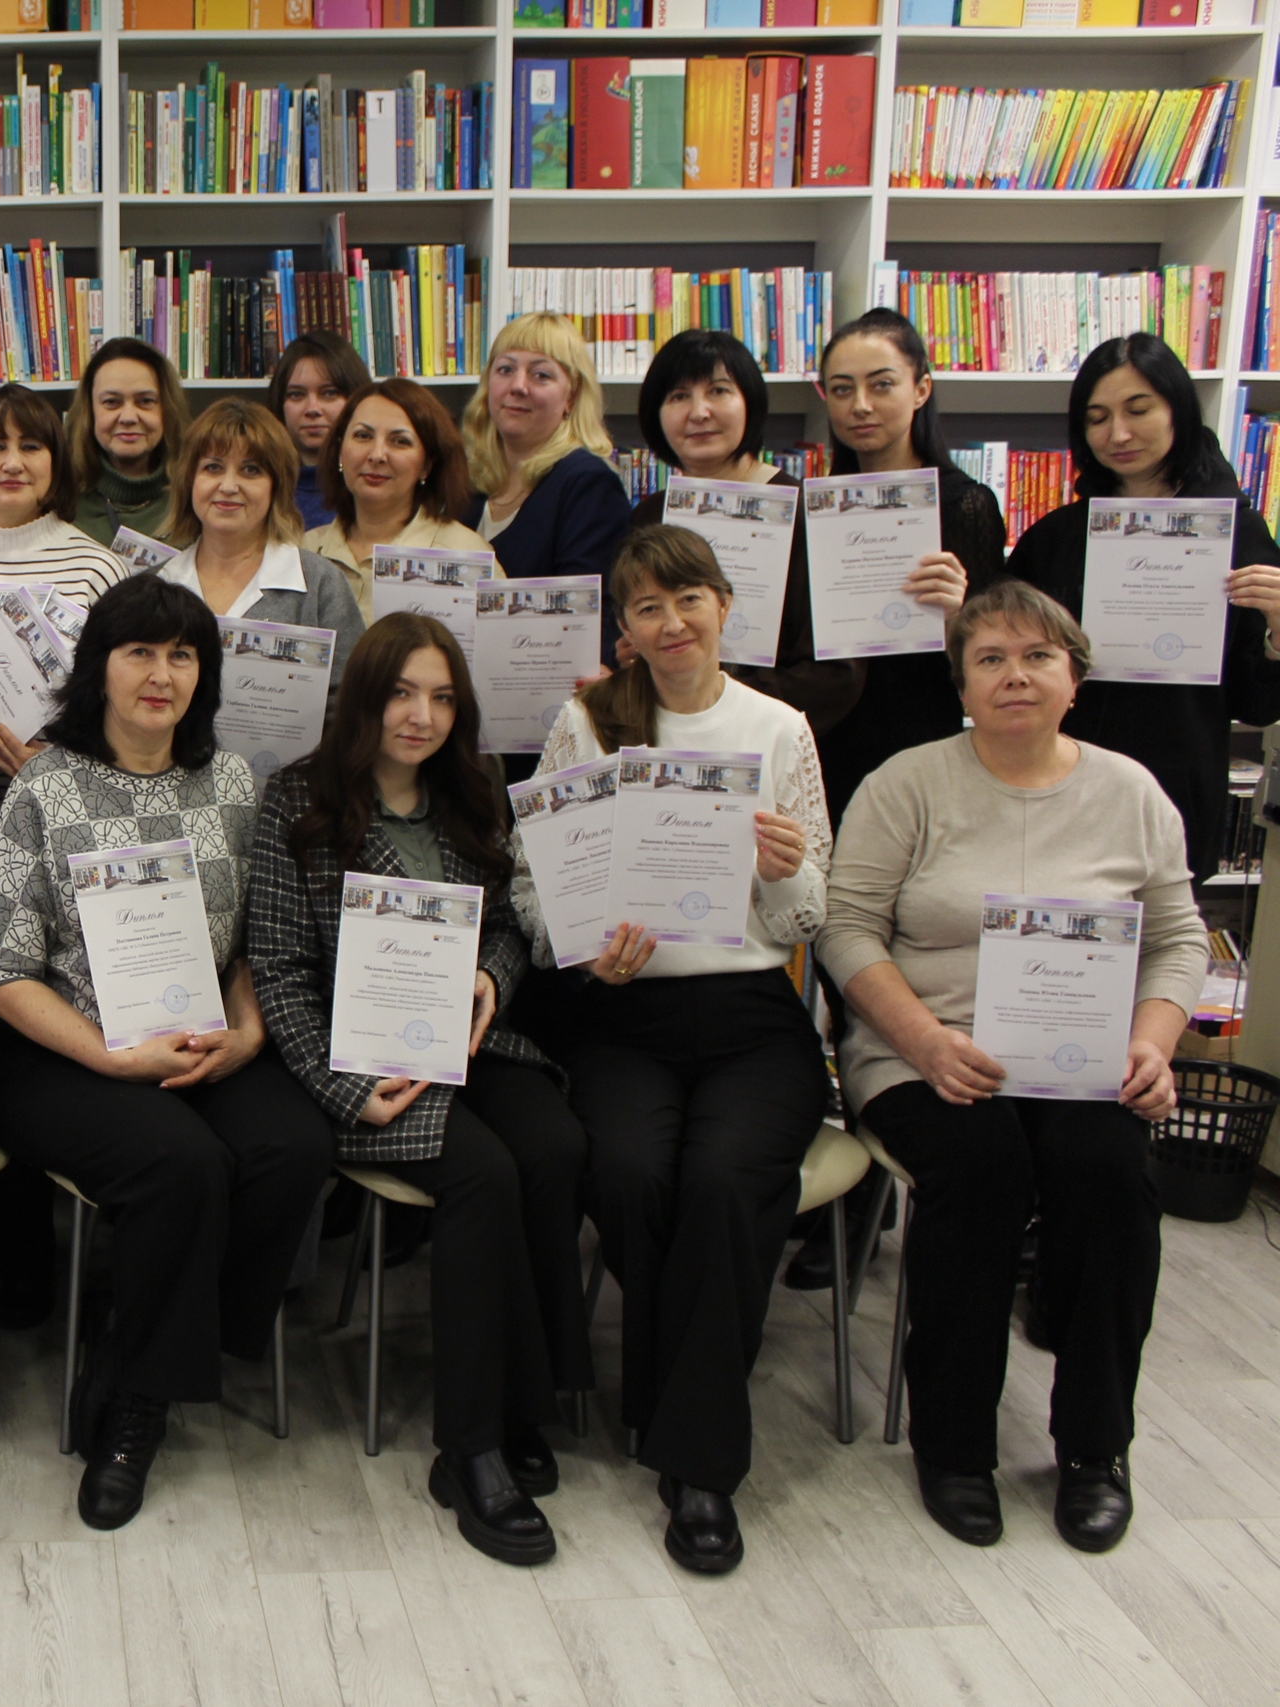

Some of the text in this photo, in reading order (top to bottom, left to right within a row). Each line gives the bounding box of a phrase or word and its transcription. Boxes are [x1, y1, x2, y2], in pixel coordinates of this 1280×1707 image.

[376, 97, 384, 114] Т
[634, 80, 644, 128] ПОДАРОК
[810, 64, 825, 179] КНИЖКИ В ПОДАРОК
[748, 93, 760, 183] ЛЕСНЫЕ СКАЗКИ
[634, 139, 643, 186] КНИЖКИ
[34, 247, 44, 276] СОВЕТЫ
[37, 276, 46, 312] ВРЕДНЫЕ
[40, 312, 48, 339] САМЫЕ
[844, 530, 899, 547] Диплом
[1125, 556, 1184, 572] Диплом
[510, 633, 563, 649] Диплом
[234, 674, 287, 695] Диплом
[654, 810, 714, 829] Диплом
[565, 826, 613, 847] Дипло
[115, 908, 165, 927] Диплом
[376, 937, 433, 959] Диплом
[1021, 958, 1087, 979] Диплом
